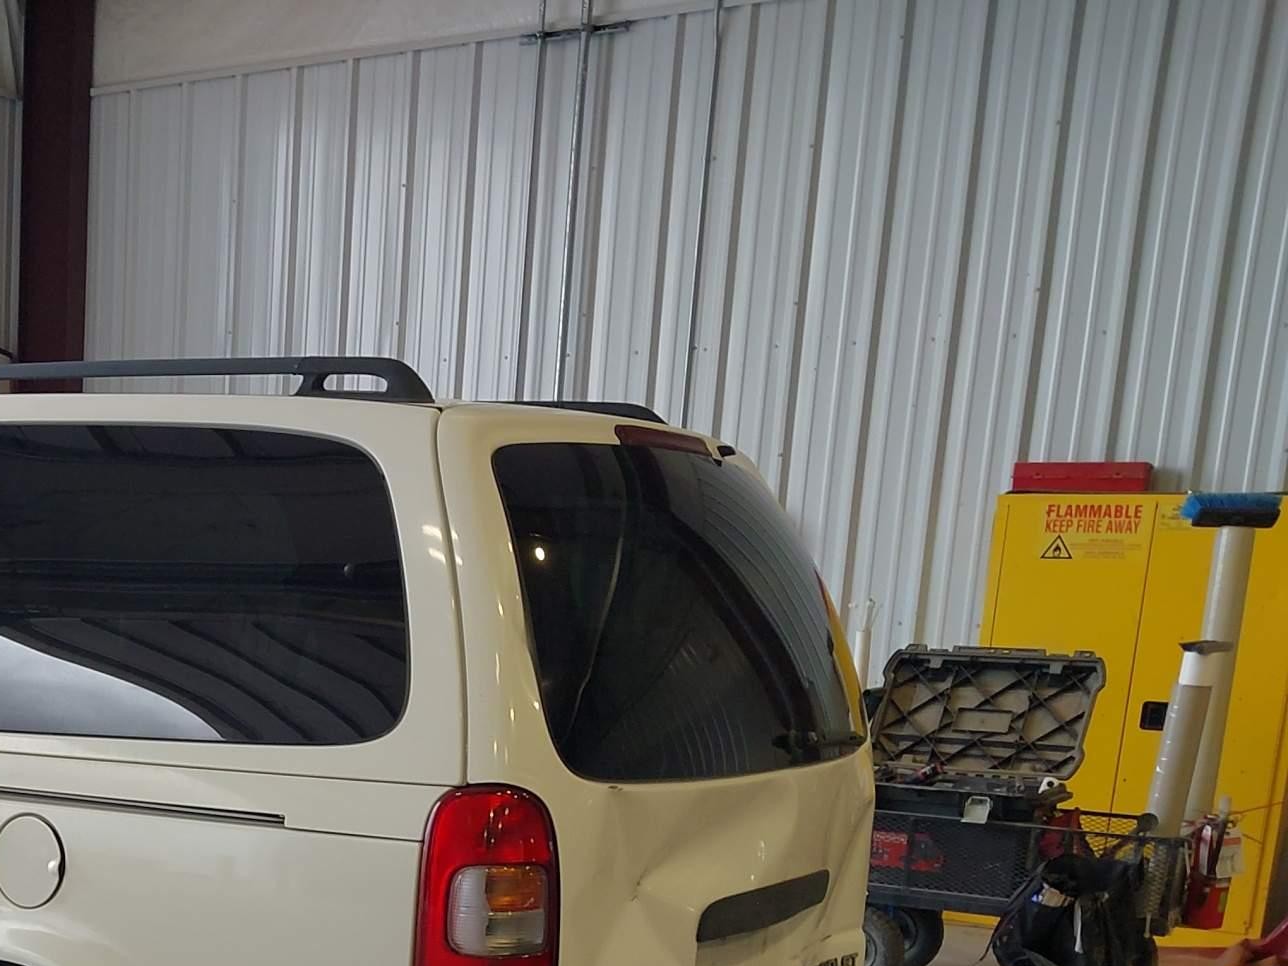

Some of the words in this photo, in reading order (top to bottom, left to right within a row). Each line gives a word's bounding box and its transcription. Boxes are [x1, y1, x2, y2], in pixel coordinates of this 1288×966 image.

[1046, 504, 1143, 519] FLAMMABLE
[1045, 519, 1073, 533] KEEP
[1076, 519, 1103, 534] FIRE
[1105, 520, 1140, 534] AWAY
